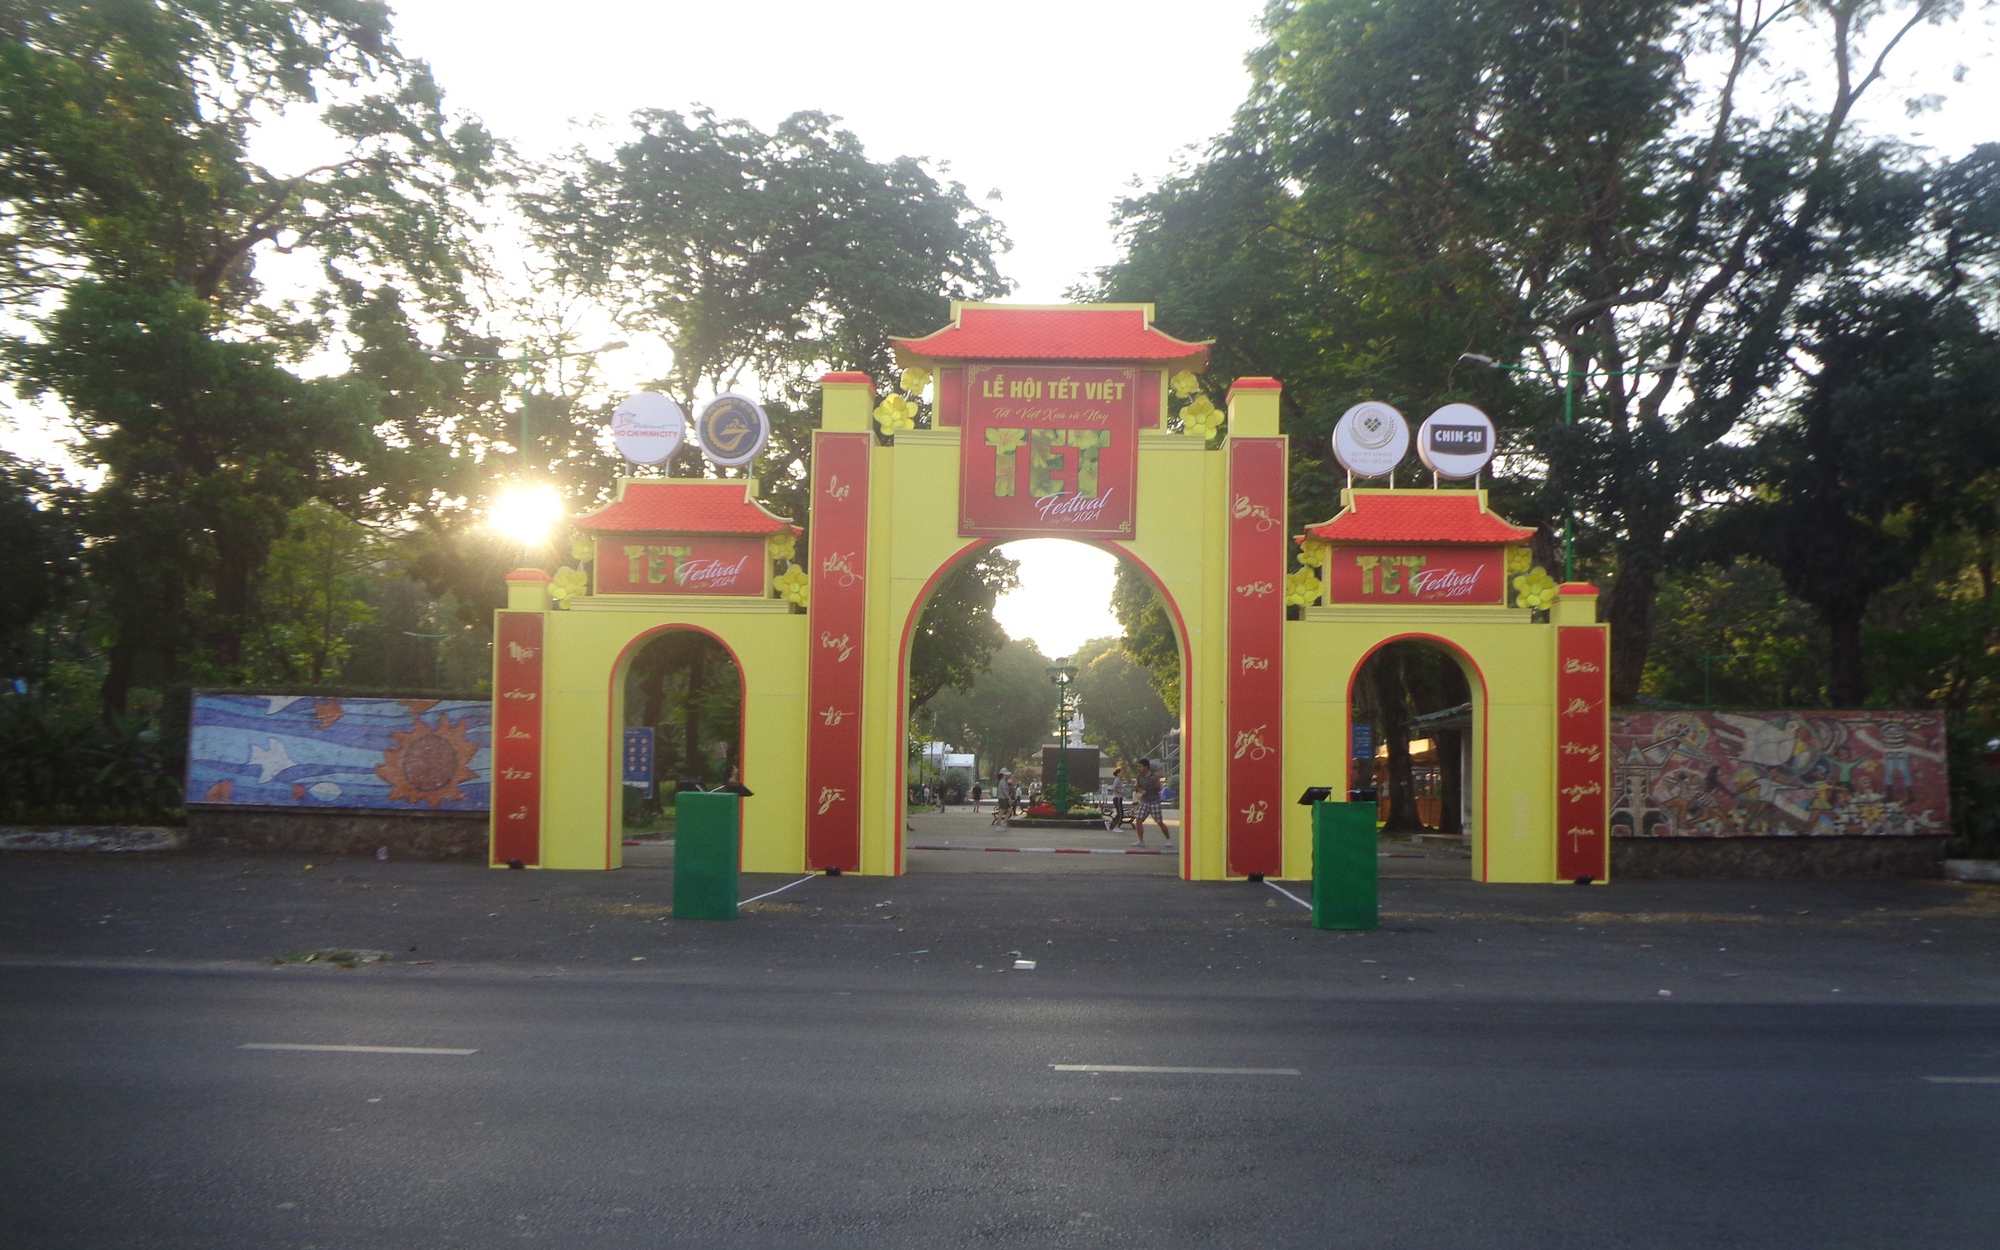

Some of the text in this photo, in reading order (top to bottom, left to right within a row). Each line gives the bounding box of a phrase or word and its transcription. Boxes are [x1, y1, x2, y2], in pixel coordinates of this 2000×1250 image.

[983, 374, 1125, 404] LỄ HỘI TẾT VIỆT
[993, 408, 1011, 420] Tết
[1015, 408, 1040, 421] Việt
[1083, 409, 1109, 424] Nay
[660, 430, 678, 438] CITY
[1435, 430, 1482, 443] CHIN-SU
[985, 427, 1111, 498] TET
[1034, 487, 1114, 522] Festival
[1072, 509, 1102, 523] 2024
[623, 545, 691, 584] TET
[674, 555, 748, 587] Festival
[1356, 556, 1427, 594] TET
[710, 577, 737, 588] 2024
[1410, 564, 1484, 597] Festival
[1446, 585, 1474, 598] 2024
